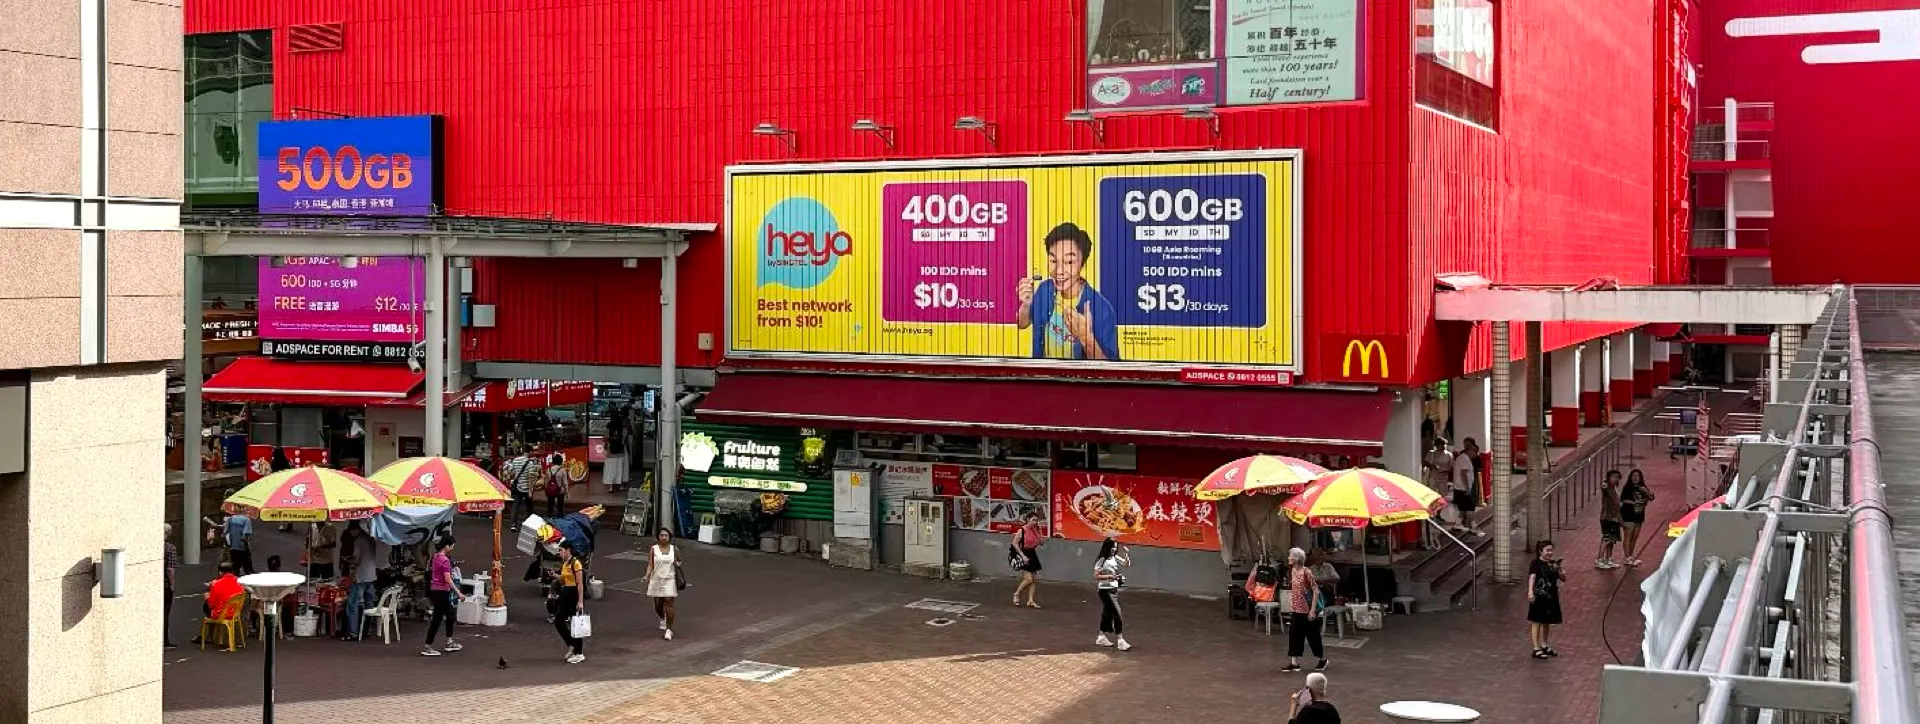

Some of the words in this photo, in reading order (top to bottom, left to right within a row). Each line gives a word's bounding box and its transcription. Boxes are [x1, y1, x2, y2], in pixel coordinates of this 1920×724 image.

[1270, 27, 1297, 39] 百年
[1294, 37, 1337, 51] 五十年
[1280, 63, 1301, 72] 100
[1303, 59, 1339, 74] years!
[1249, 86, 1279, 100] Half
[1284, 85, 1331, 99] century!
[278, 145, 412, 190] 500GB
[901, 194, 1008, 224] 400GB
[1124, 188, 1243, 222] 600GB
[767, 223, 852, 266] heya
[1164, 245, 1182, 253] Asia
[1183, 245, 1222, 255] Roaming
[920, 266, 938, 276] 100
[939, 266, 958, 276] IDD
[960, 265, 987, 276] mins
[1143, 266, 1165, 276] 500
[1168, 266, 1189, 276] IDD
[1191, 265, 1222, 276] mins
[281, 274, 306, 288] 600
[914, 281, 958, 310] $10
[973, 299, 994, 310] days
[1137, 282, 1185, 313] $13
[1203, 300, 1228, 313] days
[274, 296, 305, 310] FREE
[375, 295, 397, 312] $12
[757, 299, 789, 311] Best
[792, 299, 853, 312] network
[372, 323, 404, 333] SIMBA
[757, 314, 791, 327] from
[795, 314, 823, 329] $10!
[275, 344, 320, 355] ADSPACE
[322, 345, 342, 355] FOR
[344, 346, 369, 356] RENT
[384, 347, 406, 357] 8812
[1185, 372, 1225, 380] ADSPACE
[1146, 499, 1214, 527] 麻辣烫
